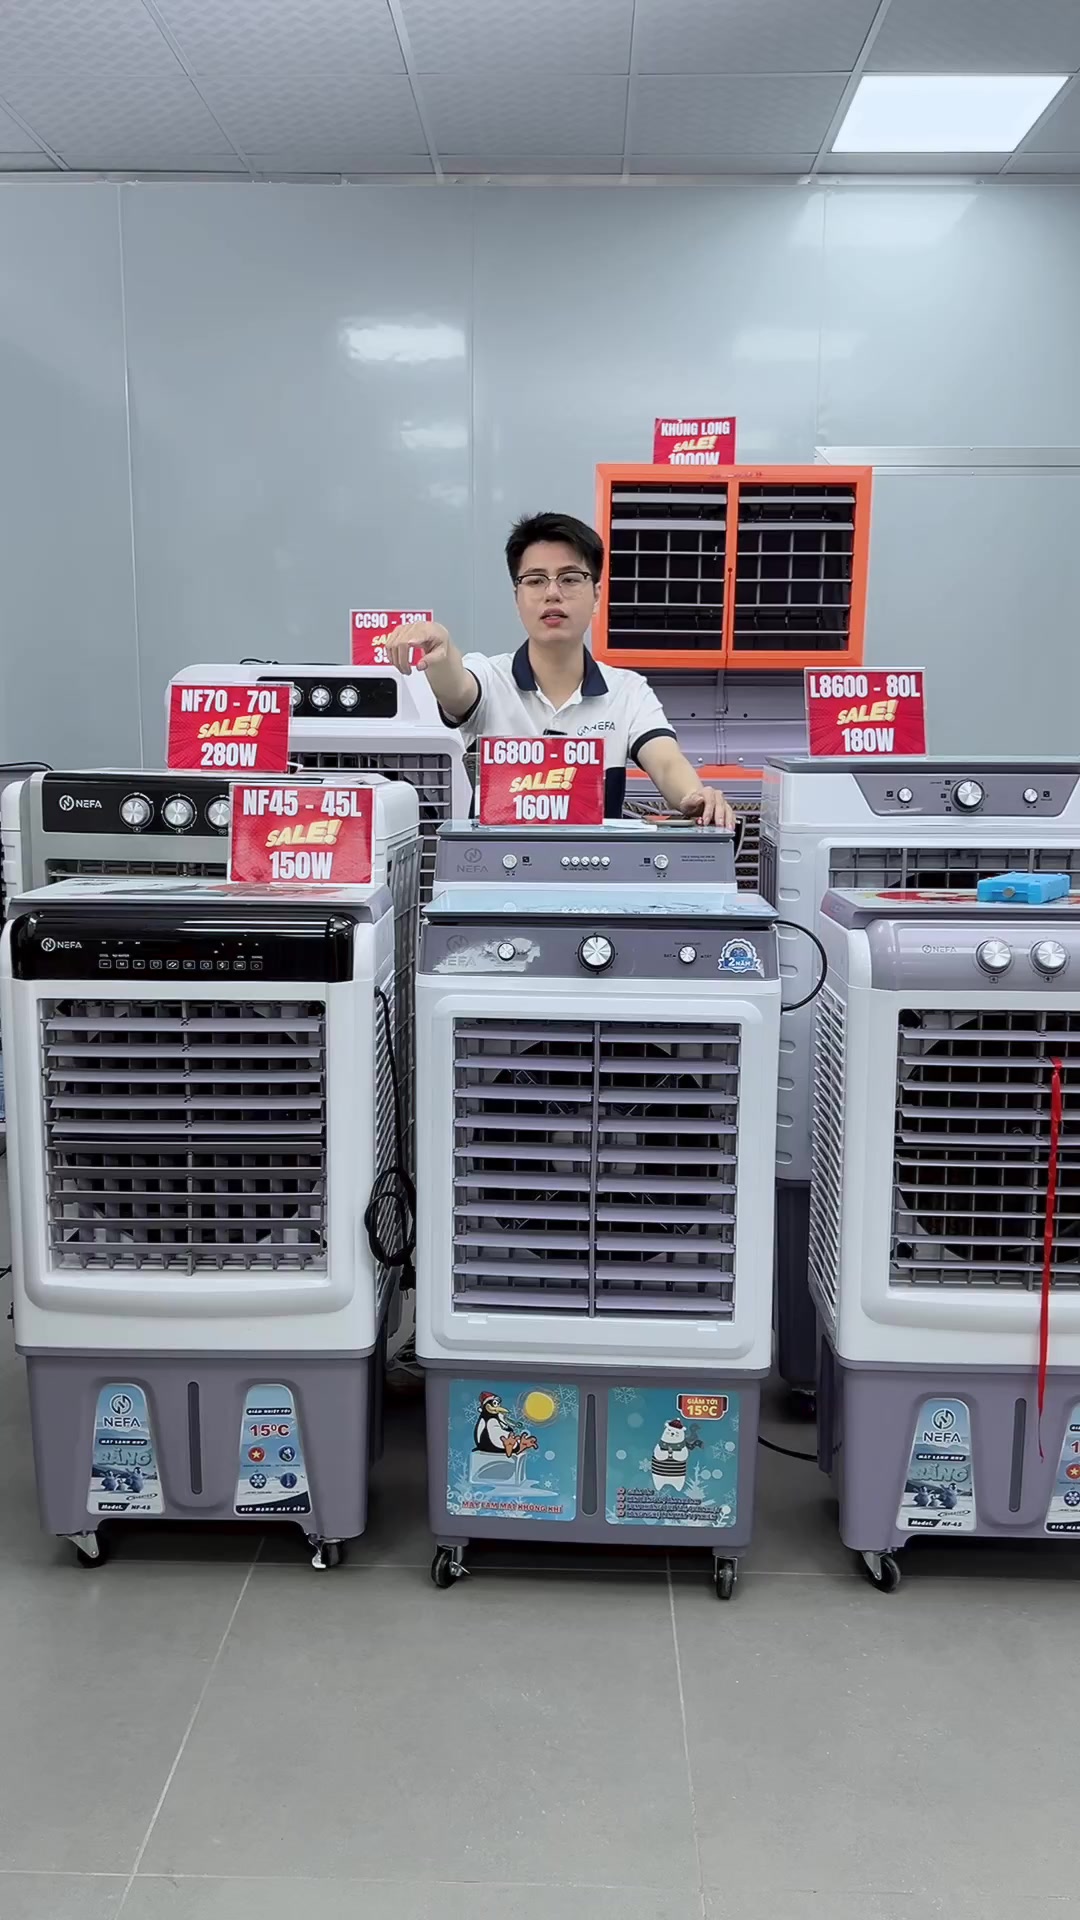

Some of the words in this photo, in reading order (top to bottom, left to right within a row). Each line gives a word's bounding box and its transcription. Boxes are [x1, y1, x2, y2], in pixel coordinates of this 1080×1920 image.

[701, 421, 731, 435] LONG
[672, 435, 718, 453] SALE!
[668, 452, 720, 465] 1000W
[355, 613, 388, 629] CC90
[809, 674, 868, 698] L8600
[886, 674, 920, 698] 80L
[181, 689, 228, 712] NF70
[247, 690, 281, 714] 70L
[836, 699, 899, 725] SALE!
[197, 714, 263, 739] SALE!
[841, 727, 895, 752] 180W
[200, 742, 258, 767] 280W
[483, 740, 545, 765] L6800
[564, 741, 600, 765] 60L
[508, 766, 578, 793] SALE!
[75, 799, 103, 809] NEFA
[242, 789, 298, 817] NF45
[320, 790, 362, 818] 45L
[513, 794, 570, 820] 160W
[265, 819, 343, 848] SALE!
[269, 851, 334, 880] 150W
[456, 865, 489, 873] NEFA
[57, 941, 83, 949] NEFA
[933, 945, 957, 953] NEFA
[728, 957, 736, 967] 2
[103, 1417, 141, 1428] NEFA
[923, 1432, 961, 1443] NEFA
